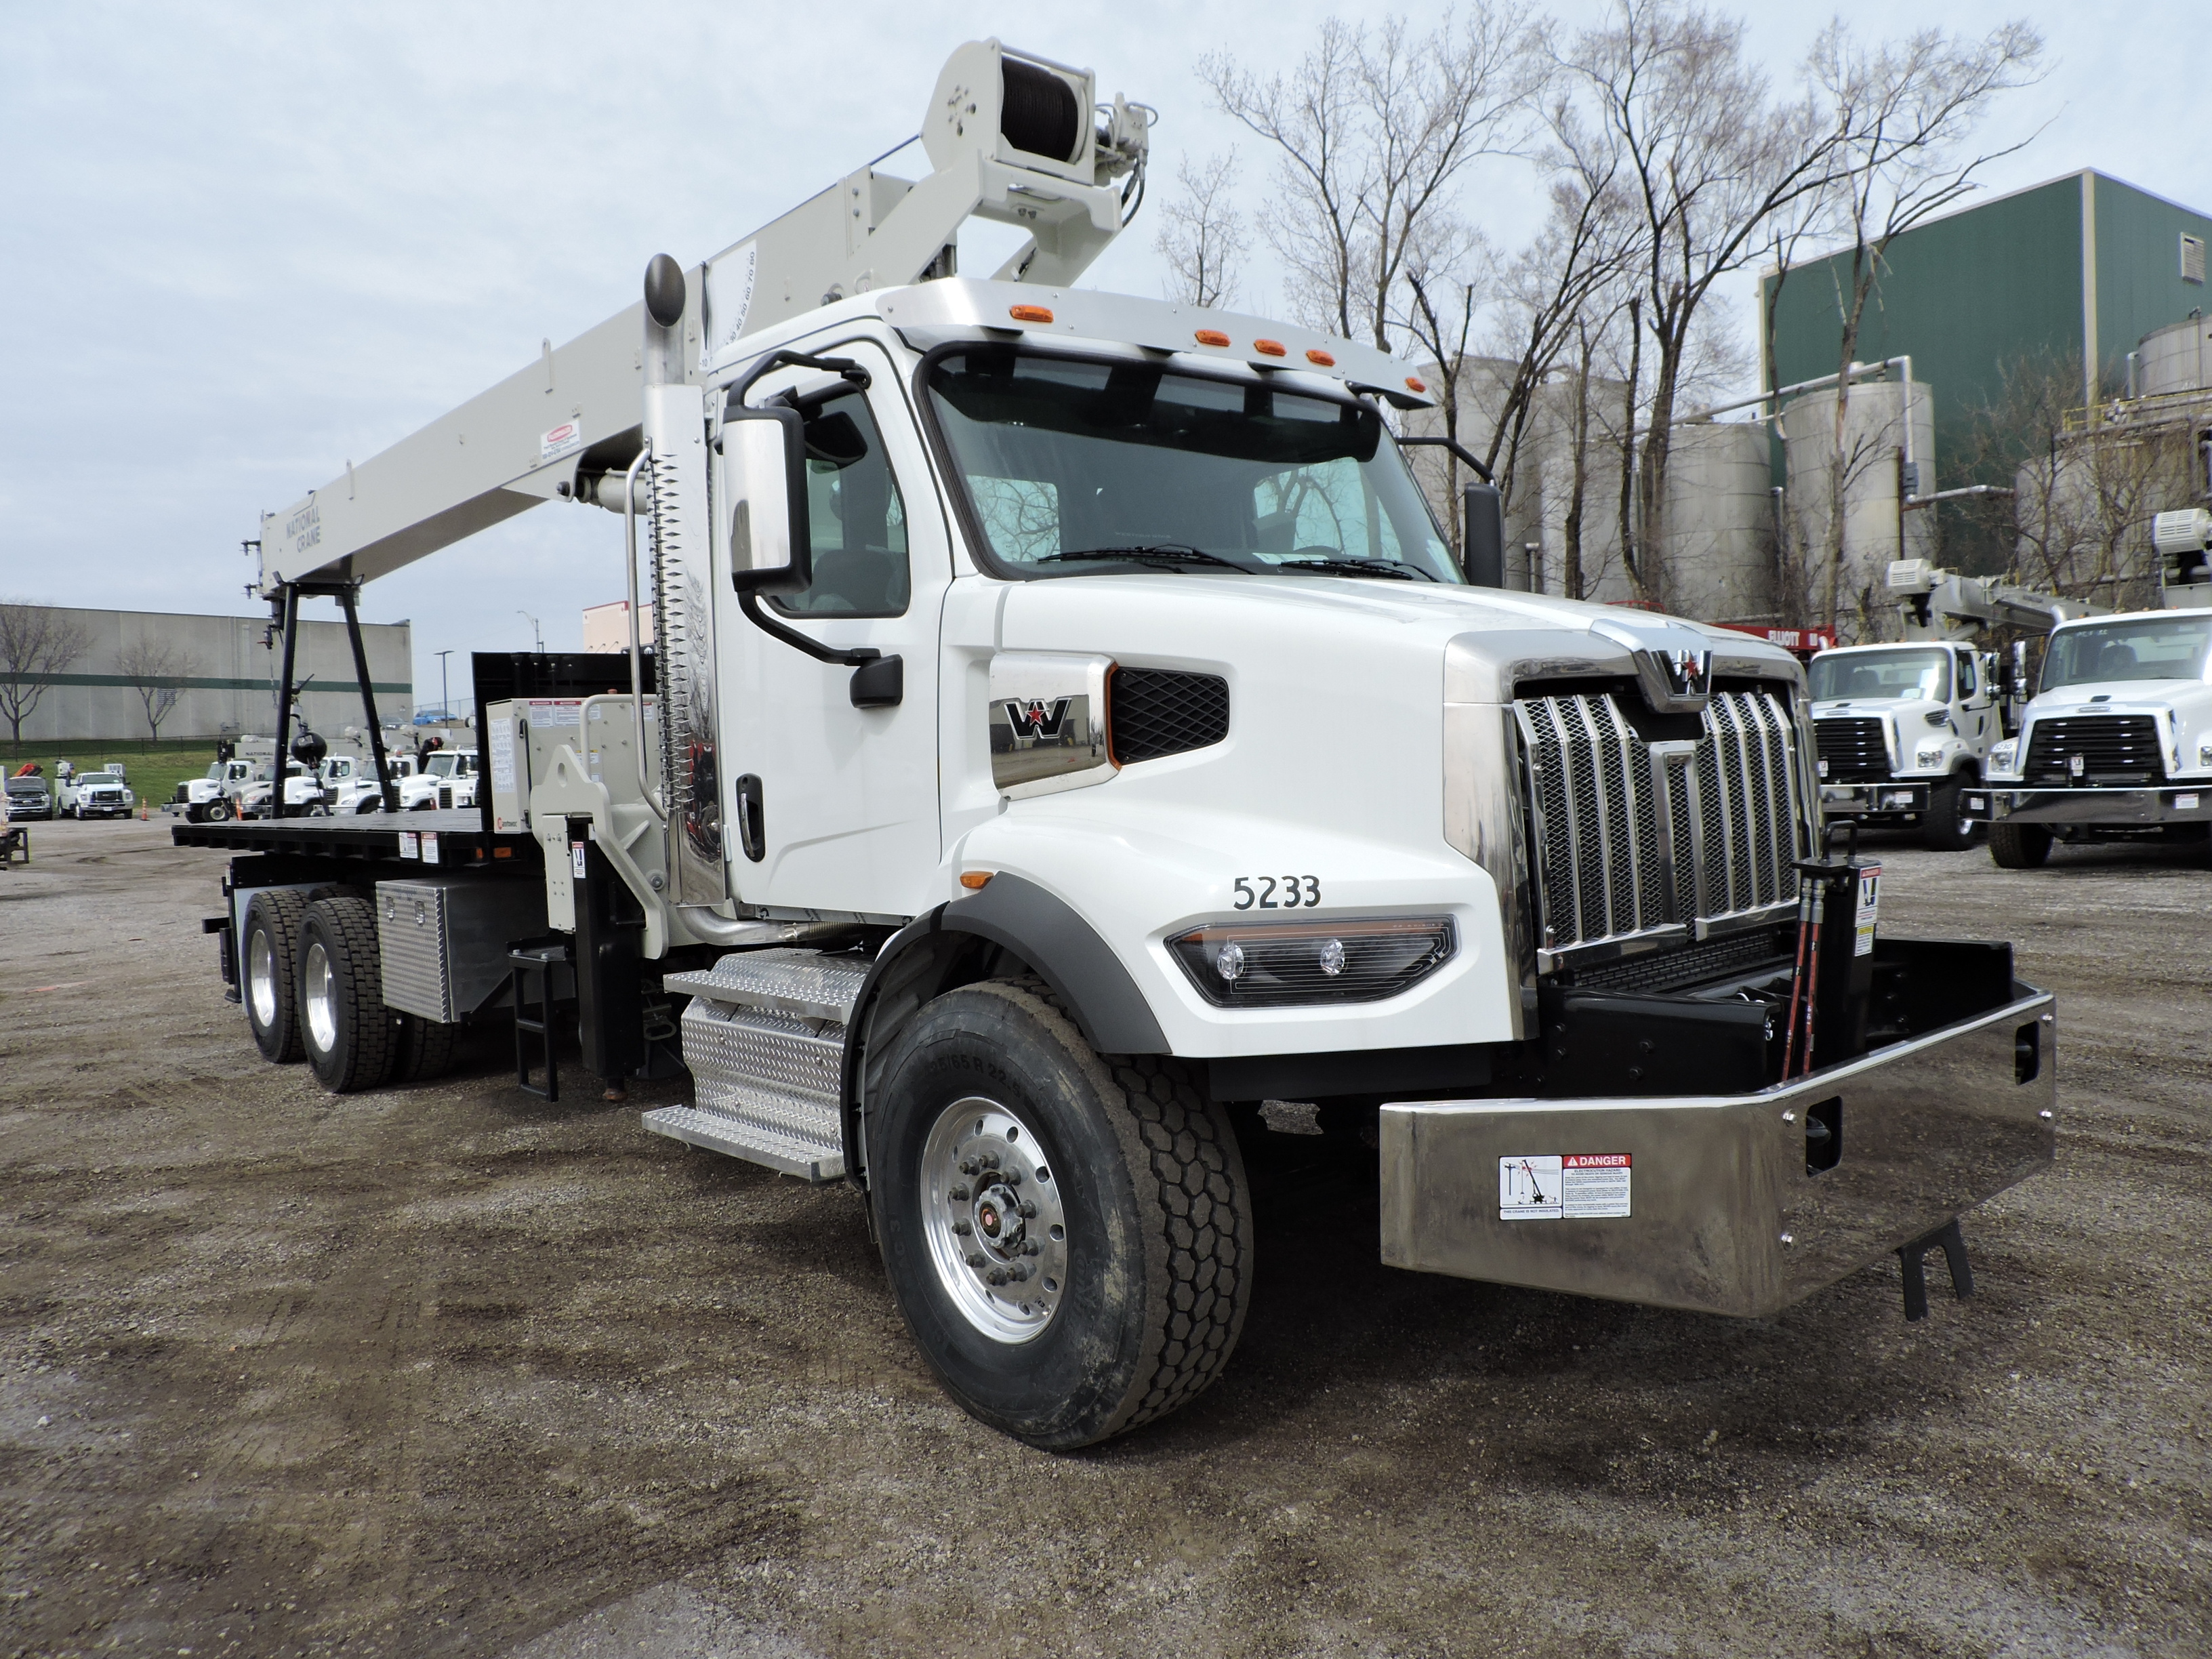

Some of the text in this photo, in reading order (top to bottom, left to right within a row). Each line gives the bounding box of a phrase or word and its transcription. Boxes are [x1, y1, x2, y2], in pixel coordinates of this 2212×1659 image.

[750, 251, 755, 265] 80
[747, 269, 754, 283] 70
[745, 287, 752, 301] 60
[741, 303, 747, 316] 50
[736, 318, 743, 331] 40
[729, 331, 737, 344] 30
[286, 506, 320, 539] NATIONAL
[297, 525, 321, 553] CRANE
[1768, 630, 1800, 647] ELLIOTT
[1233, 875, 1322, 910] 5233
[1580, 1156, 1626, 1166] DANGER
